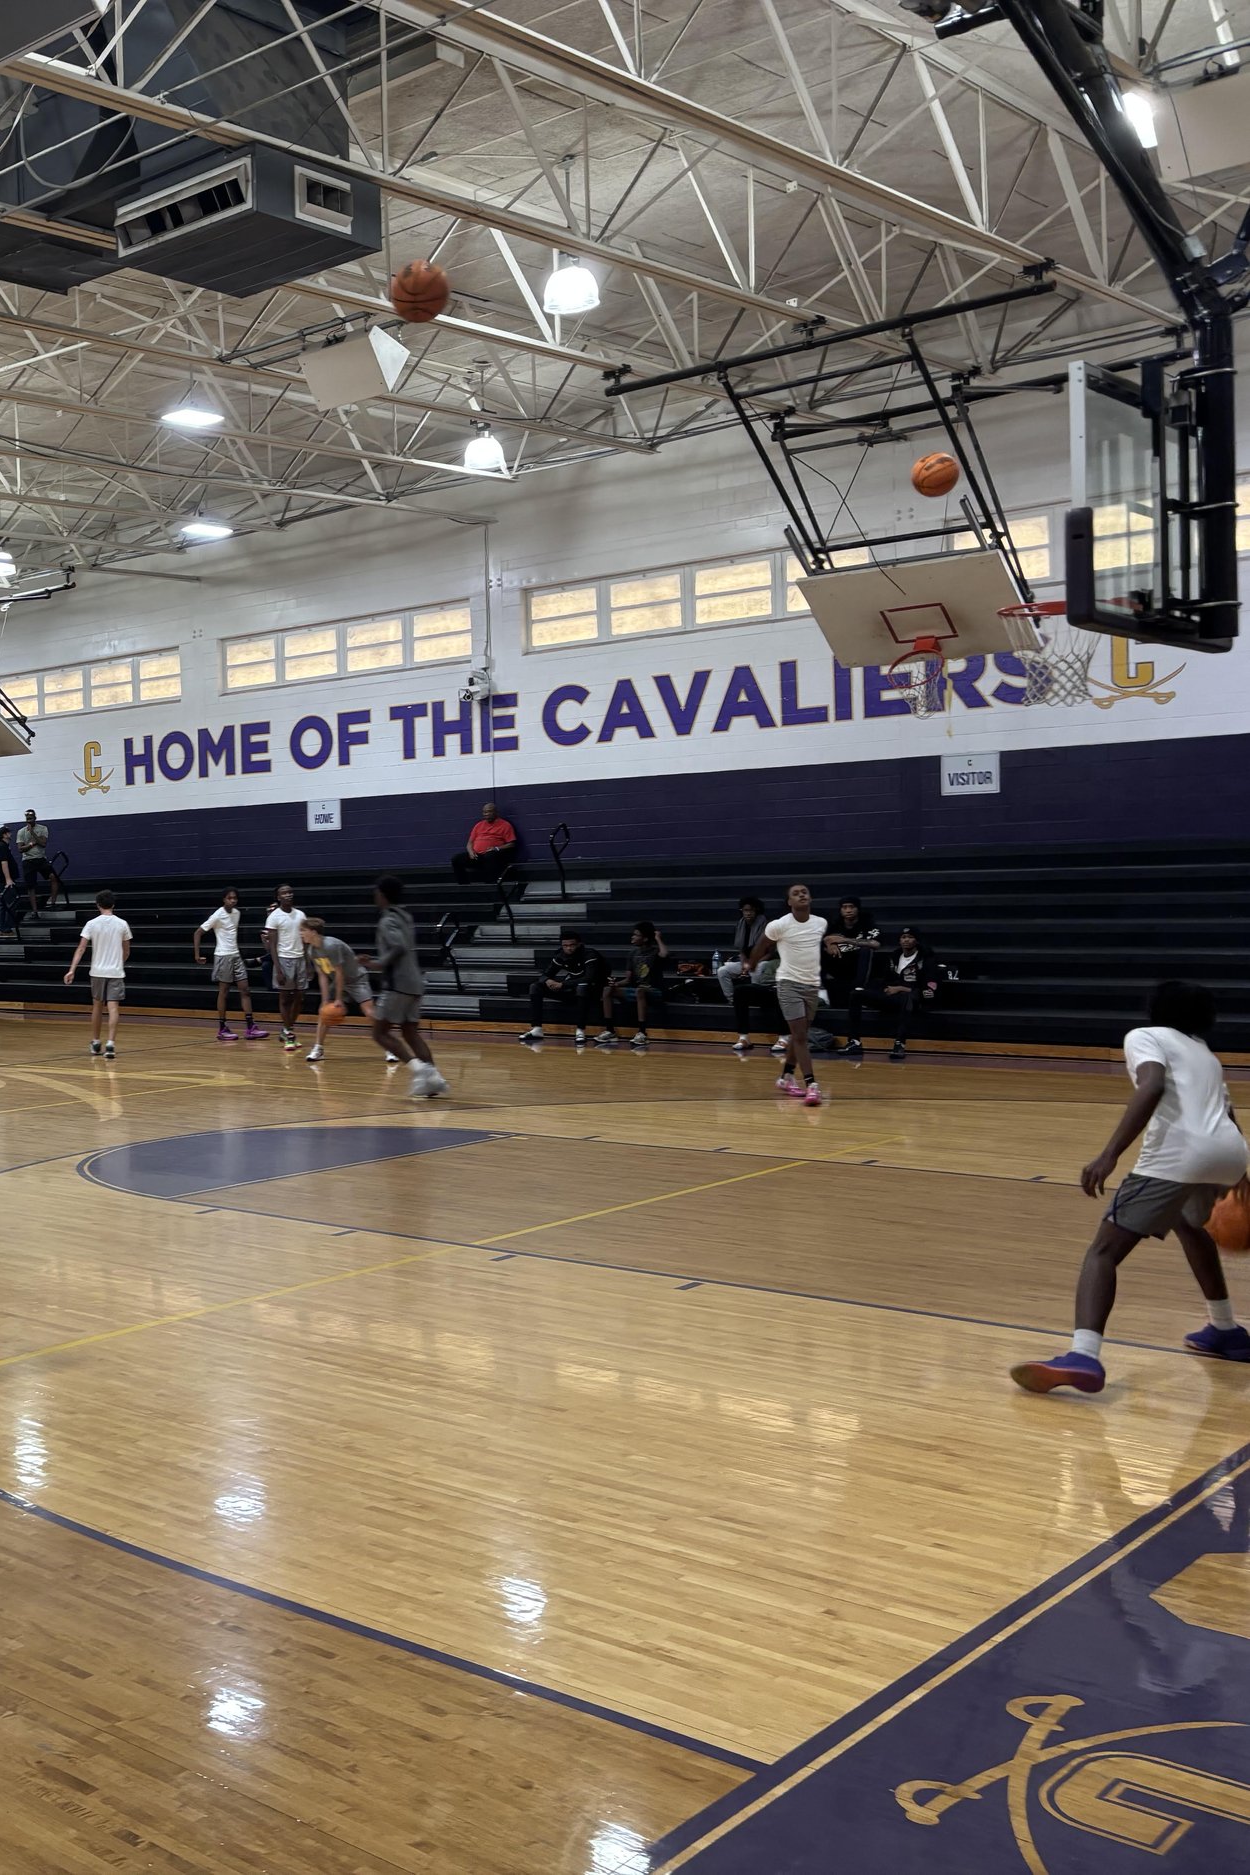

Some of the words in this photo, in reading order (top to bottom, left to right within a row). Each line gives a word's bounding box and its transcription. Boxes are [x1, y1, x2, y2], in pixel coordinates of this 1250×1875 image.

[123, 720, 272, 786] HOME
[289, 708, 371, 770] OF
[388, 691, 520, 761] THE
[83, 740, 102, 783] C
[947, 771, 993, 786] VISITOR
[314, 812, 334, 825] HOME
